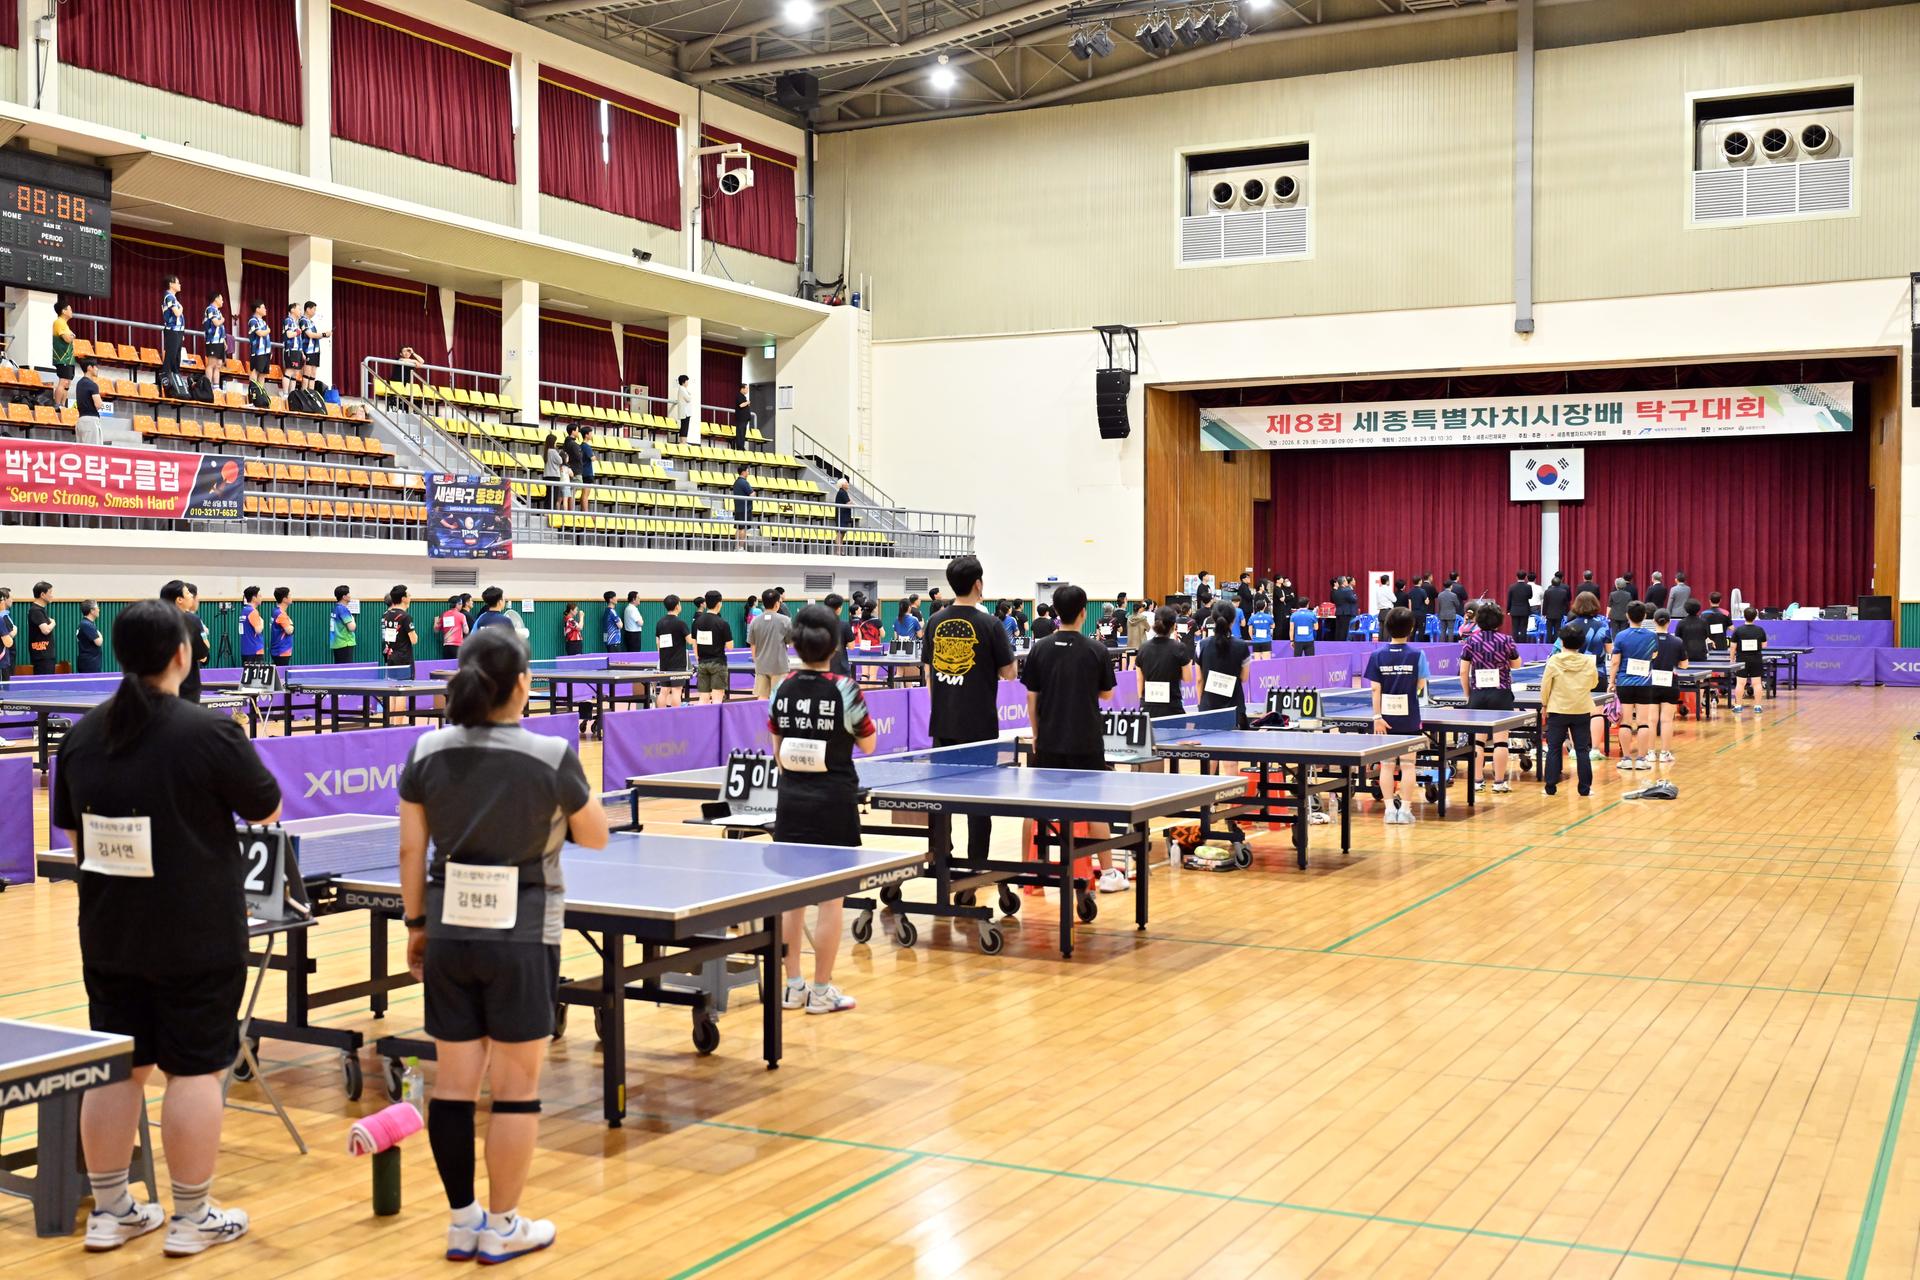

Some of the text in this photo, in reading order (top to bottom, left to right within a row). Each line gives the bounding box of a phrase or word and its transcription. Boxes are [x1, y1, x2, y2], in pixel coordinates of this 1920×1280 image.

[2, 210, 22, 220] HOME
[41, 232, 64, 243] PERIOD
[42, 254, 63, 263] PLAYER
[90, 262, 105, 271] FOUL
[1265, 396, 1765, 434] 제8회 세종특별자치시장배 탁구대회
[5, 449, 180, 492] 박신우탁구클럽
[52, 489, 99, 509] Strong,
[103, 492, 144, 509] Smash
[434, 486, 505, 506] 새샘탁구 동호회
[1259, 675, 1280, 689] XIOM
[776, 697, 836, 717] 이 예 린
[1302, 694, 1314, 716] 0
[795, 716, 813, 730] YEA
[817, 718, 835, 731] RIN
[1104, 718, 1140, 744] 1 0 1
[1158, 751, 1210, 759] BOUNDPRO
[303, 764, 398, 798] XIOM
[728, 763, 746, 798] 5
[751, 764, 764, 787] 0
[878, 799, 943, 811] BOUNDPRO
[97, 841, 136, 859] 김서연
[244, 841, 268, 891] 2
[867, 865, 918, 888] CHAMPION
[457, 891, 498, 909] 김현화
